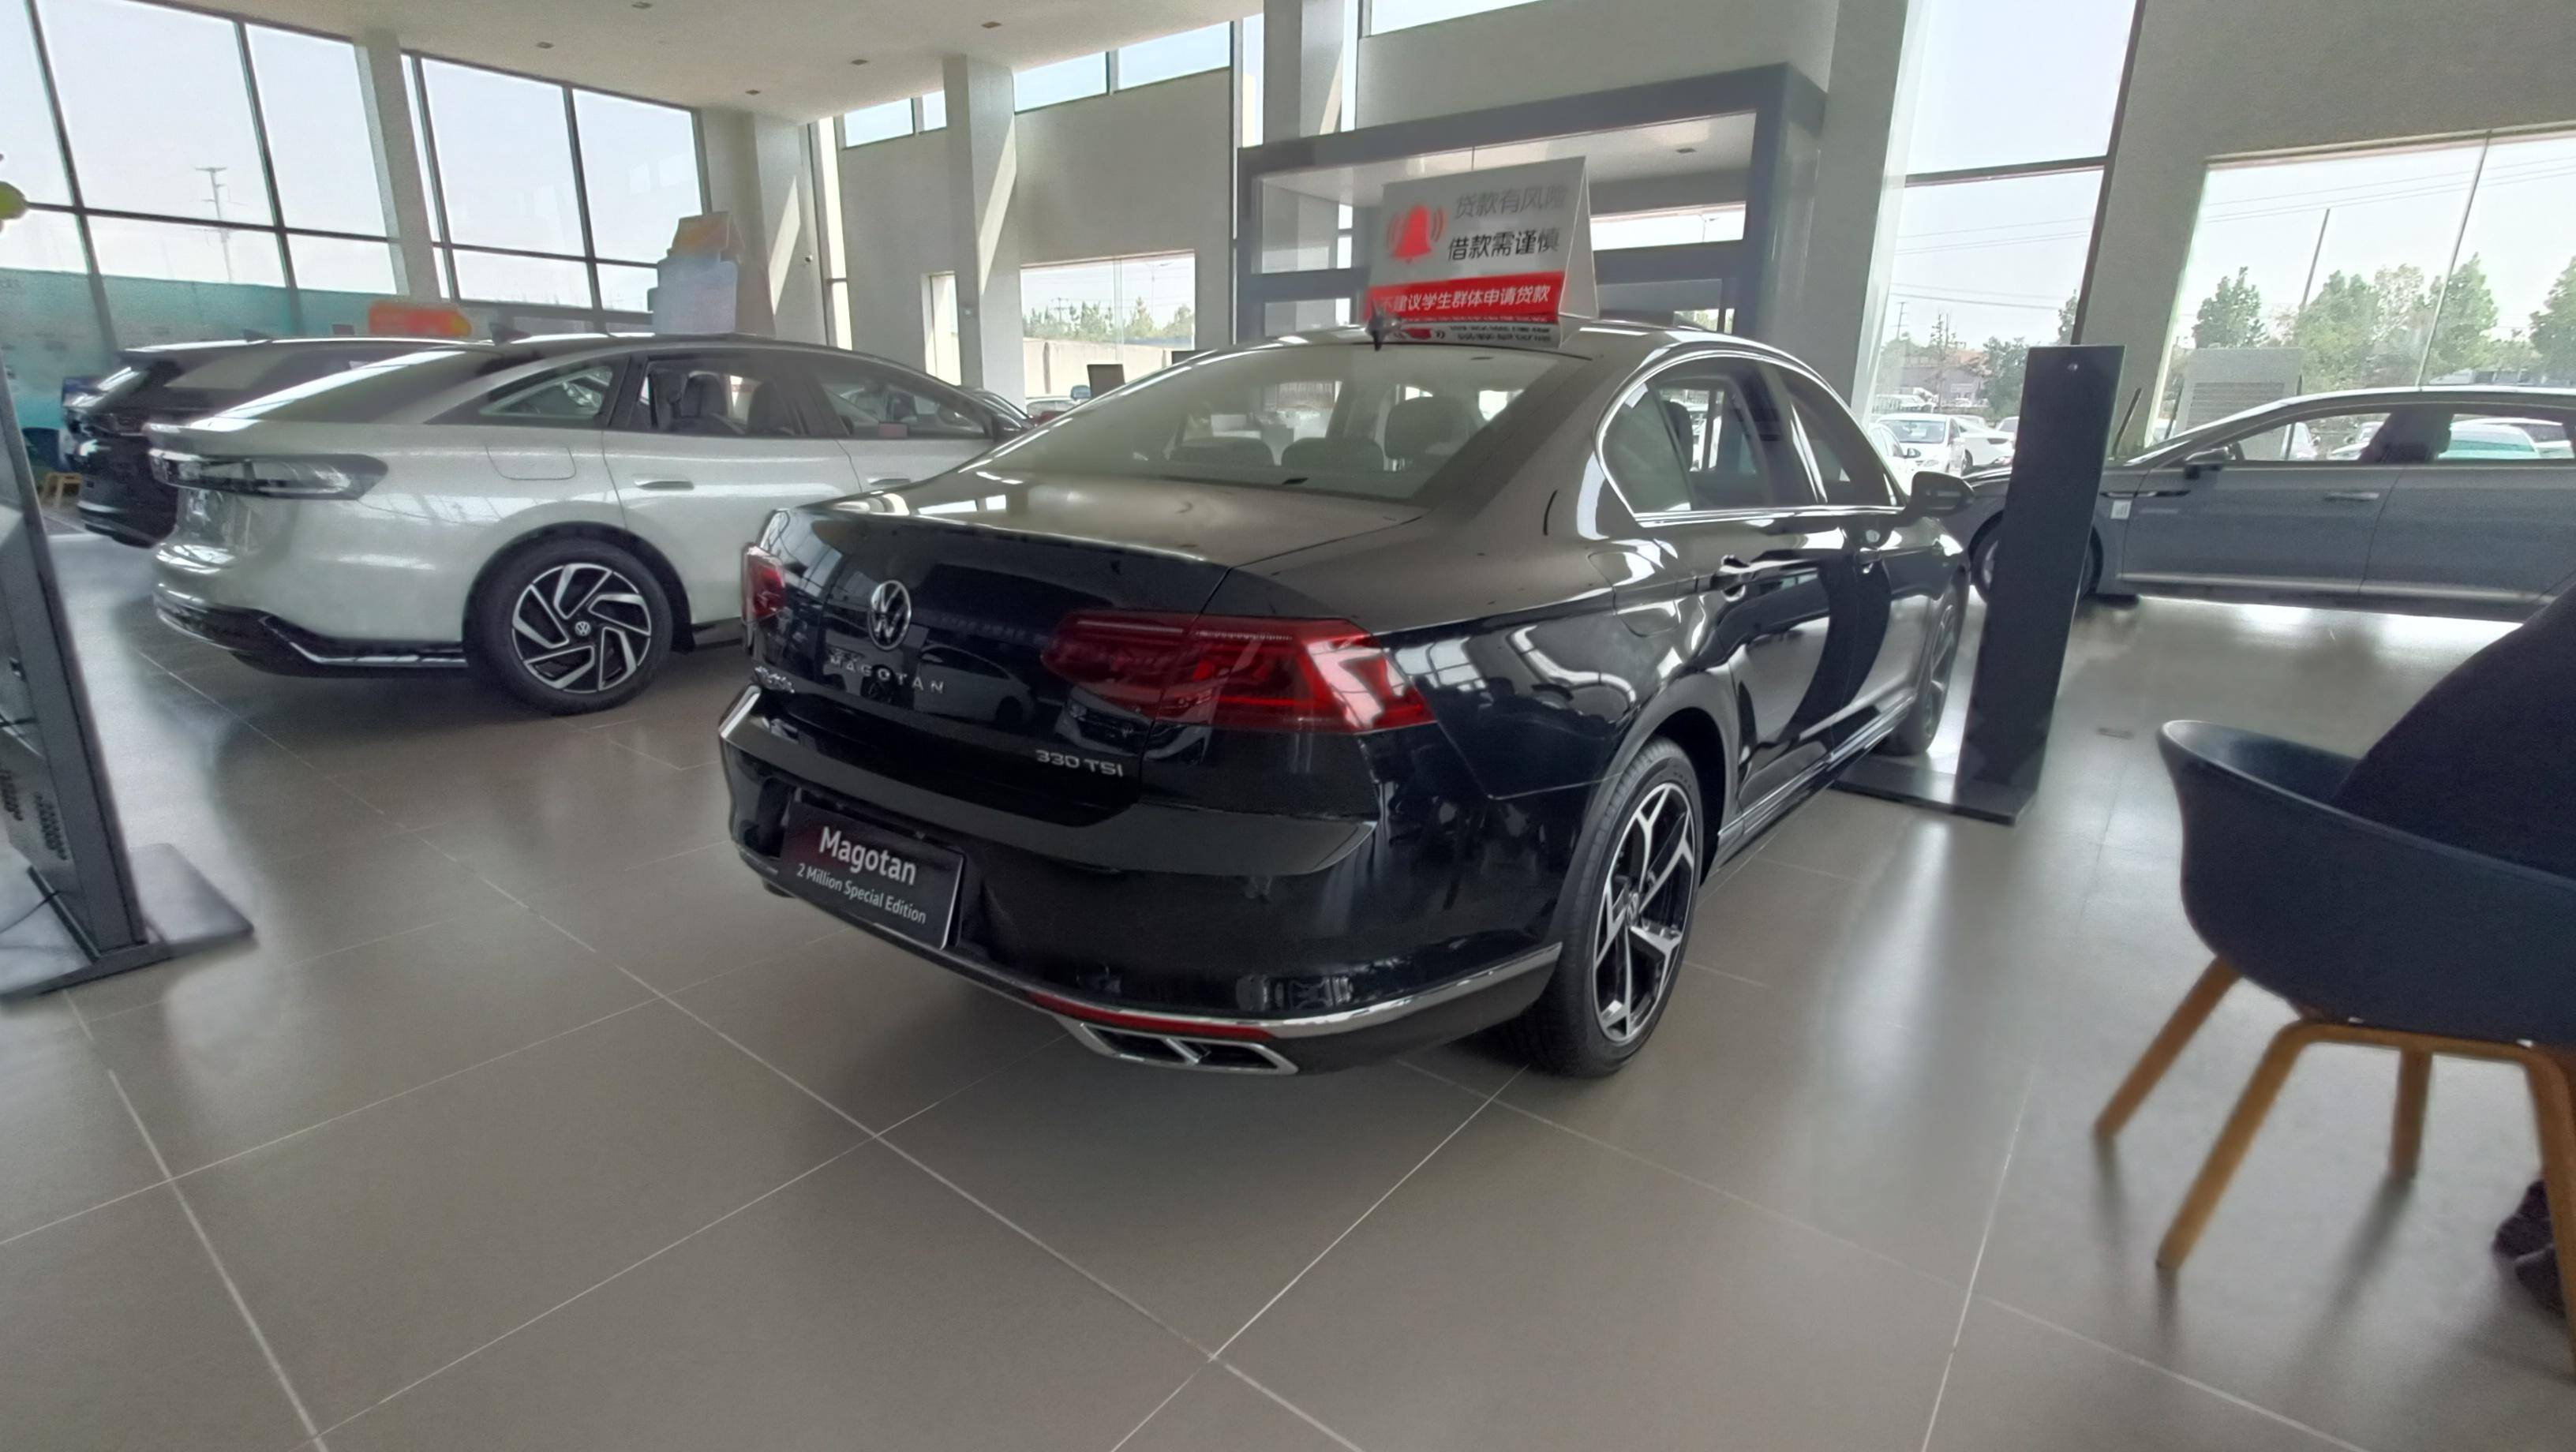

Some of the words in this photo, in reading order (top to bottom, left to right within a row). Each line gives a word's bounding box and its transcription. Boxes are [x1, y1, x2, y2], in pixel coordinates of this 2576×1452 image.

[1456, 185, 1567, 219] 贷款有风险
[1448, 228, 1560, 261] 借款需谨慎
[829, 657, 945, 694] MAGOTAN
[1035, 749, 1080, 769] 330
[1084, 758, 1123, 777] TSI
[818, 826, 917, 885] Magotan
[796, 863, 805, 878] 2
[807, 865, 843, 892] Million
[843, 880, 885, 908] Special
[885, 895, 927, 924] Edition
